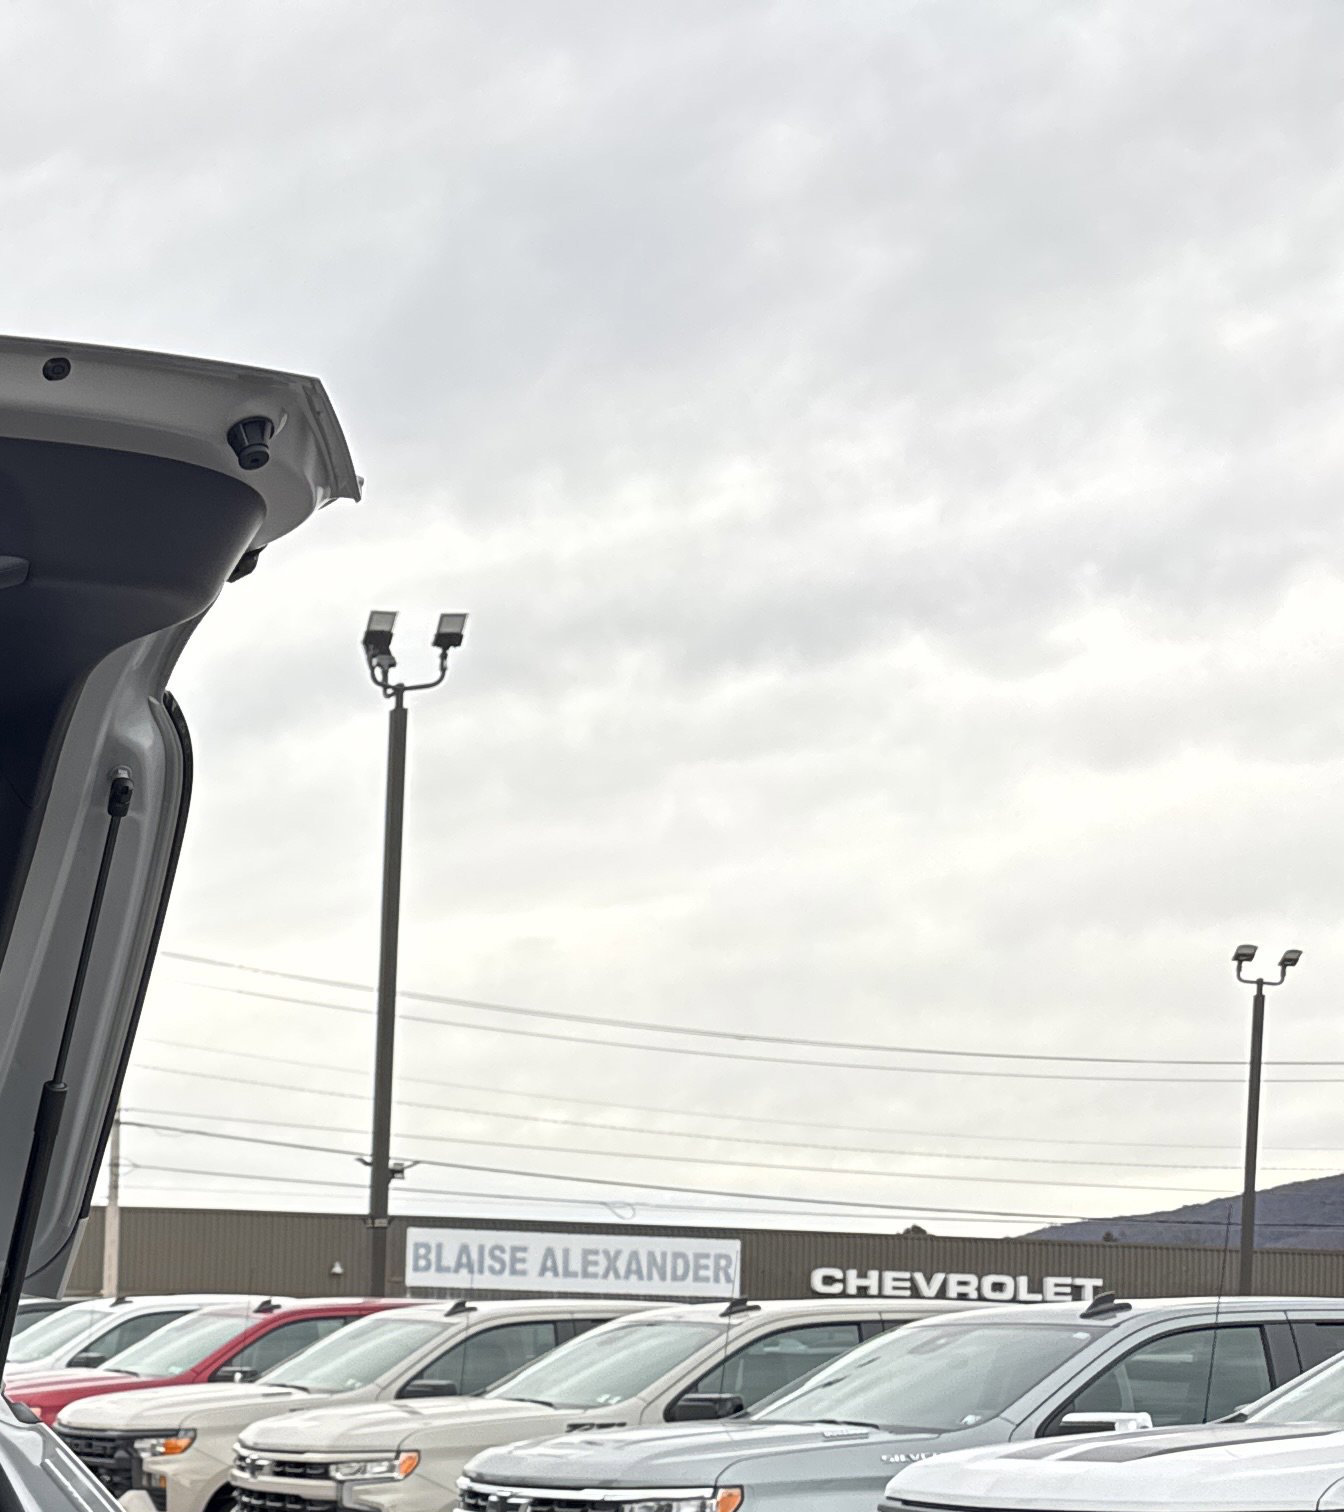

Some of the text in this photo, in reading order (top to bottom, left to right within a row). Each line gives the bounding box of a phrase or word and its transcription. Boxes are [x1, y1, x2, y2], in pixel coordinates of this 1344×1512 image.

[411, 1240, 734, 1285] BLAISE ALEXANDER
[811, 1267, 1104, 1302] CHEVROLET
